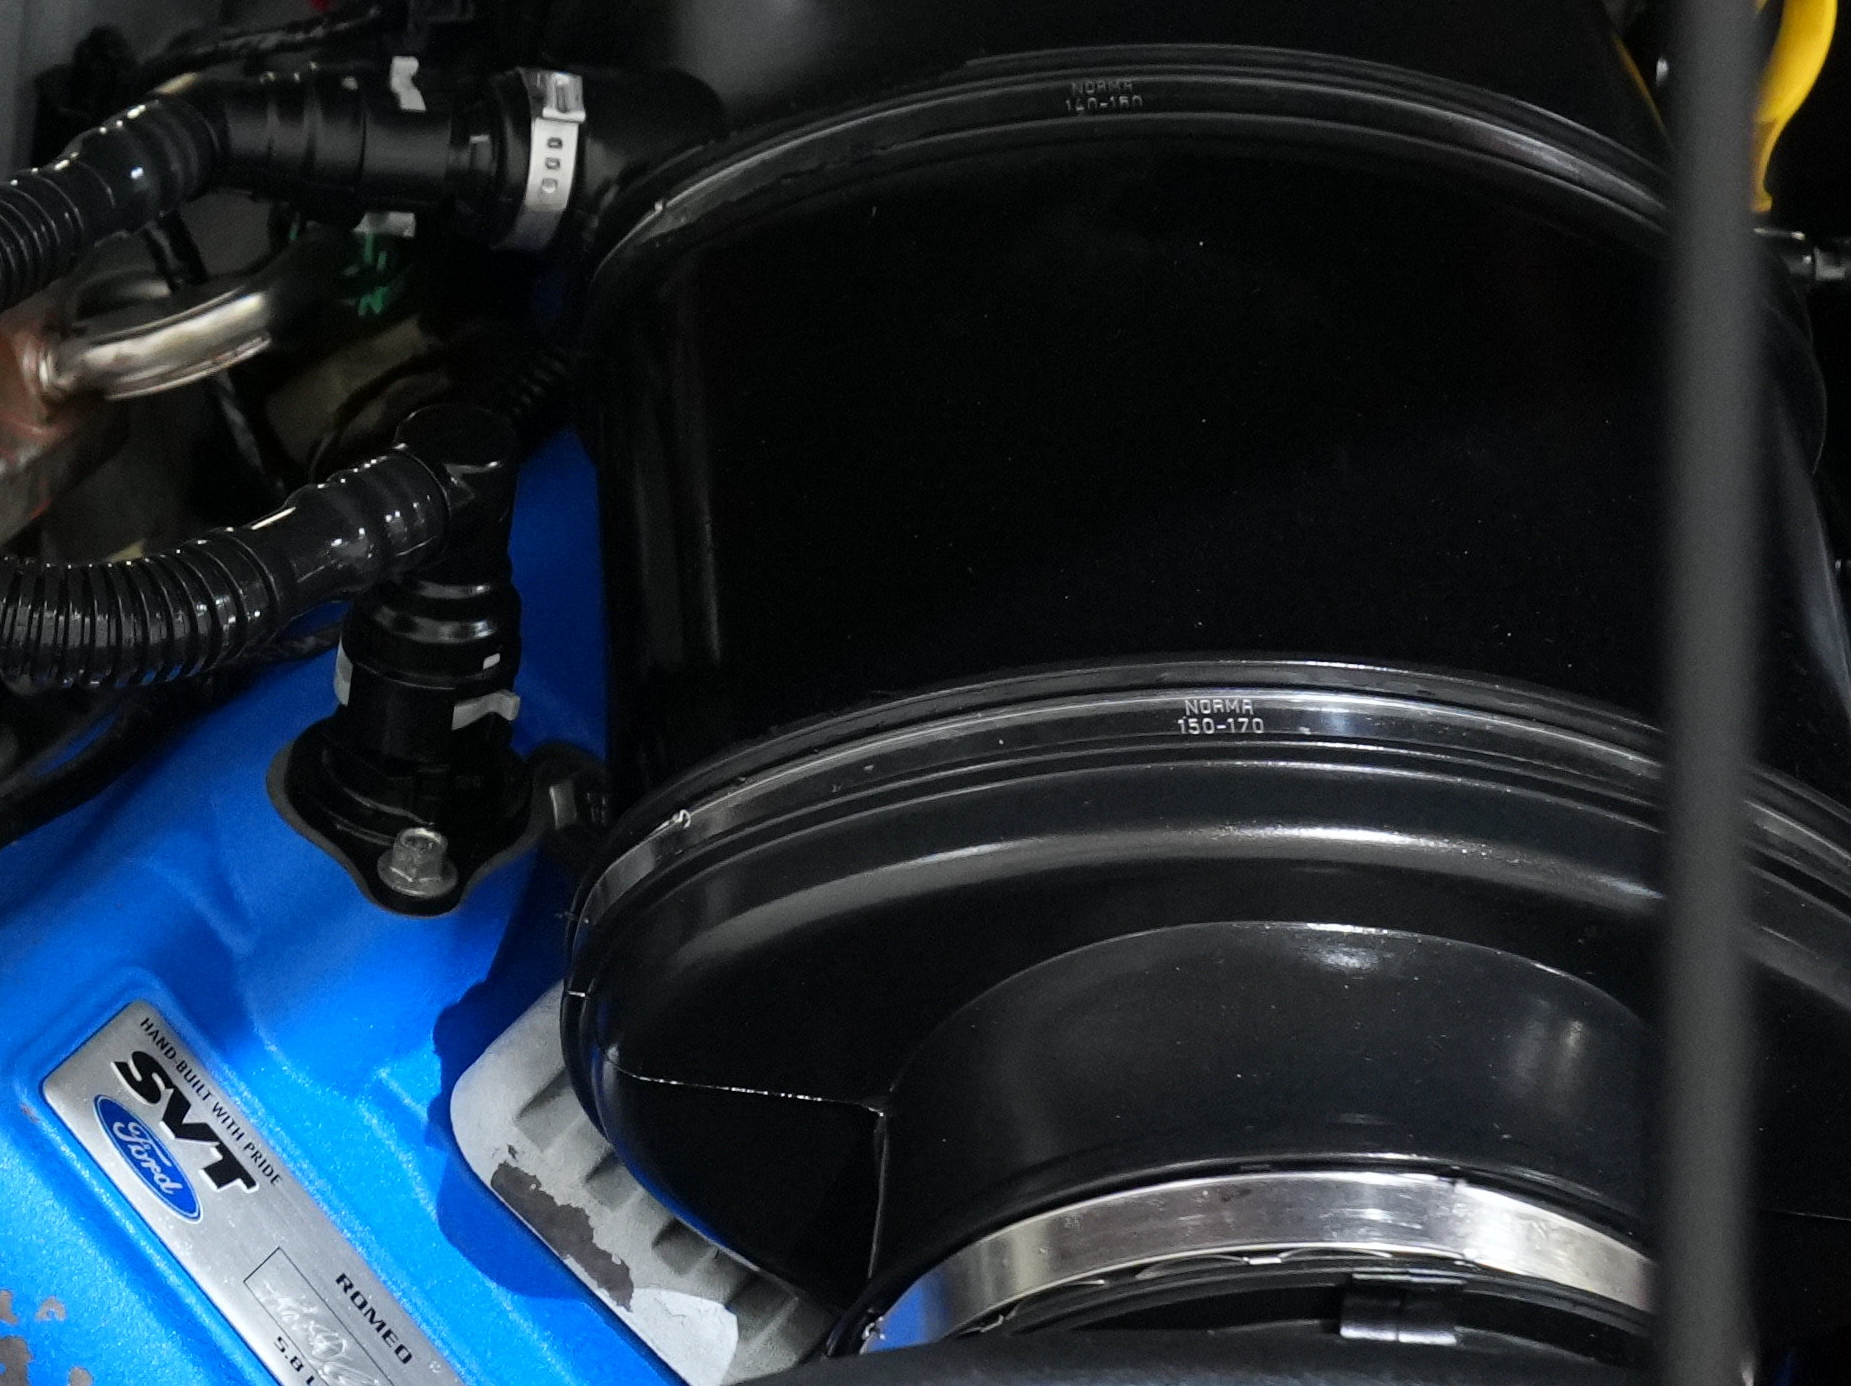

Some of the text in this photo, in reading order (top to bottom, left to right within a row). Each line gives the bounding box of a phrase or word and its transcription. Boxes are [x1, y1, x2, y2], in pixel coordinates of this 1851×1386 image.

[1176, 716, 1265, 735] 150-170
[1183, 698, 1254, 716] NORMA
[108, 1036, 259, 1215] SVT
[135, 1011, 285, 1190] HAND-BUILT WITH PRIDE
[103, 1107, 189, 1205] Ford
[270, 1333, 307, 1374] 5.8
[334, 1268, 415, 1368] ROMEO
